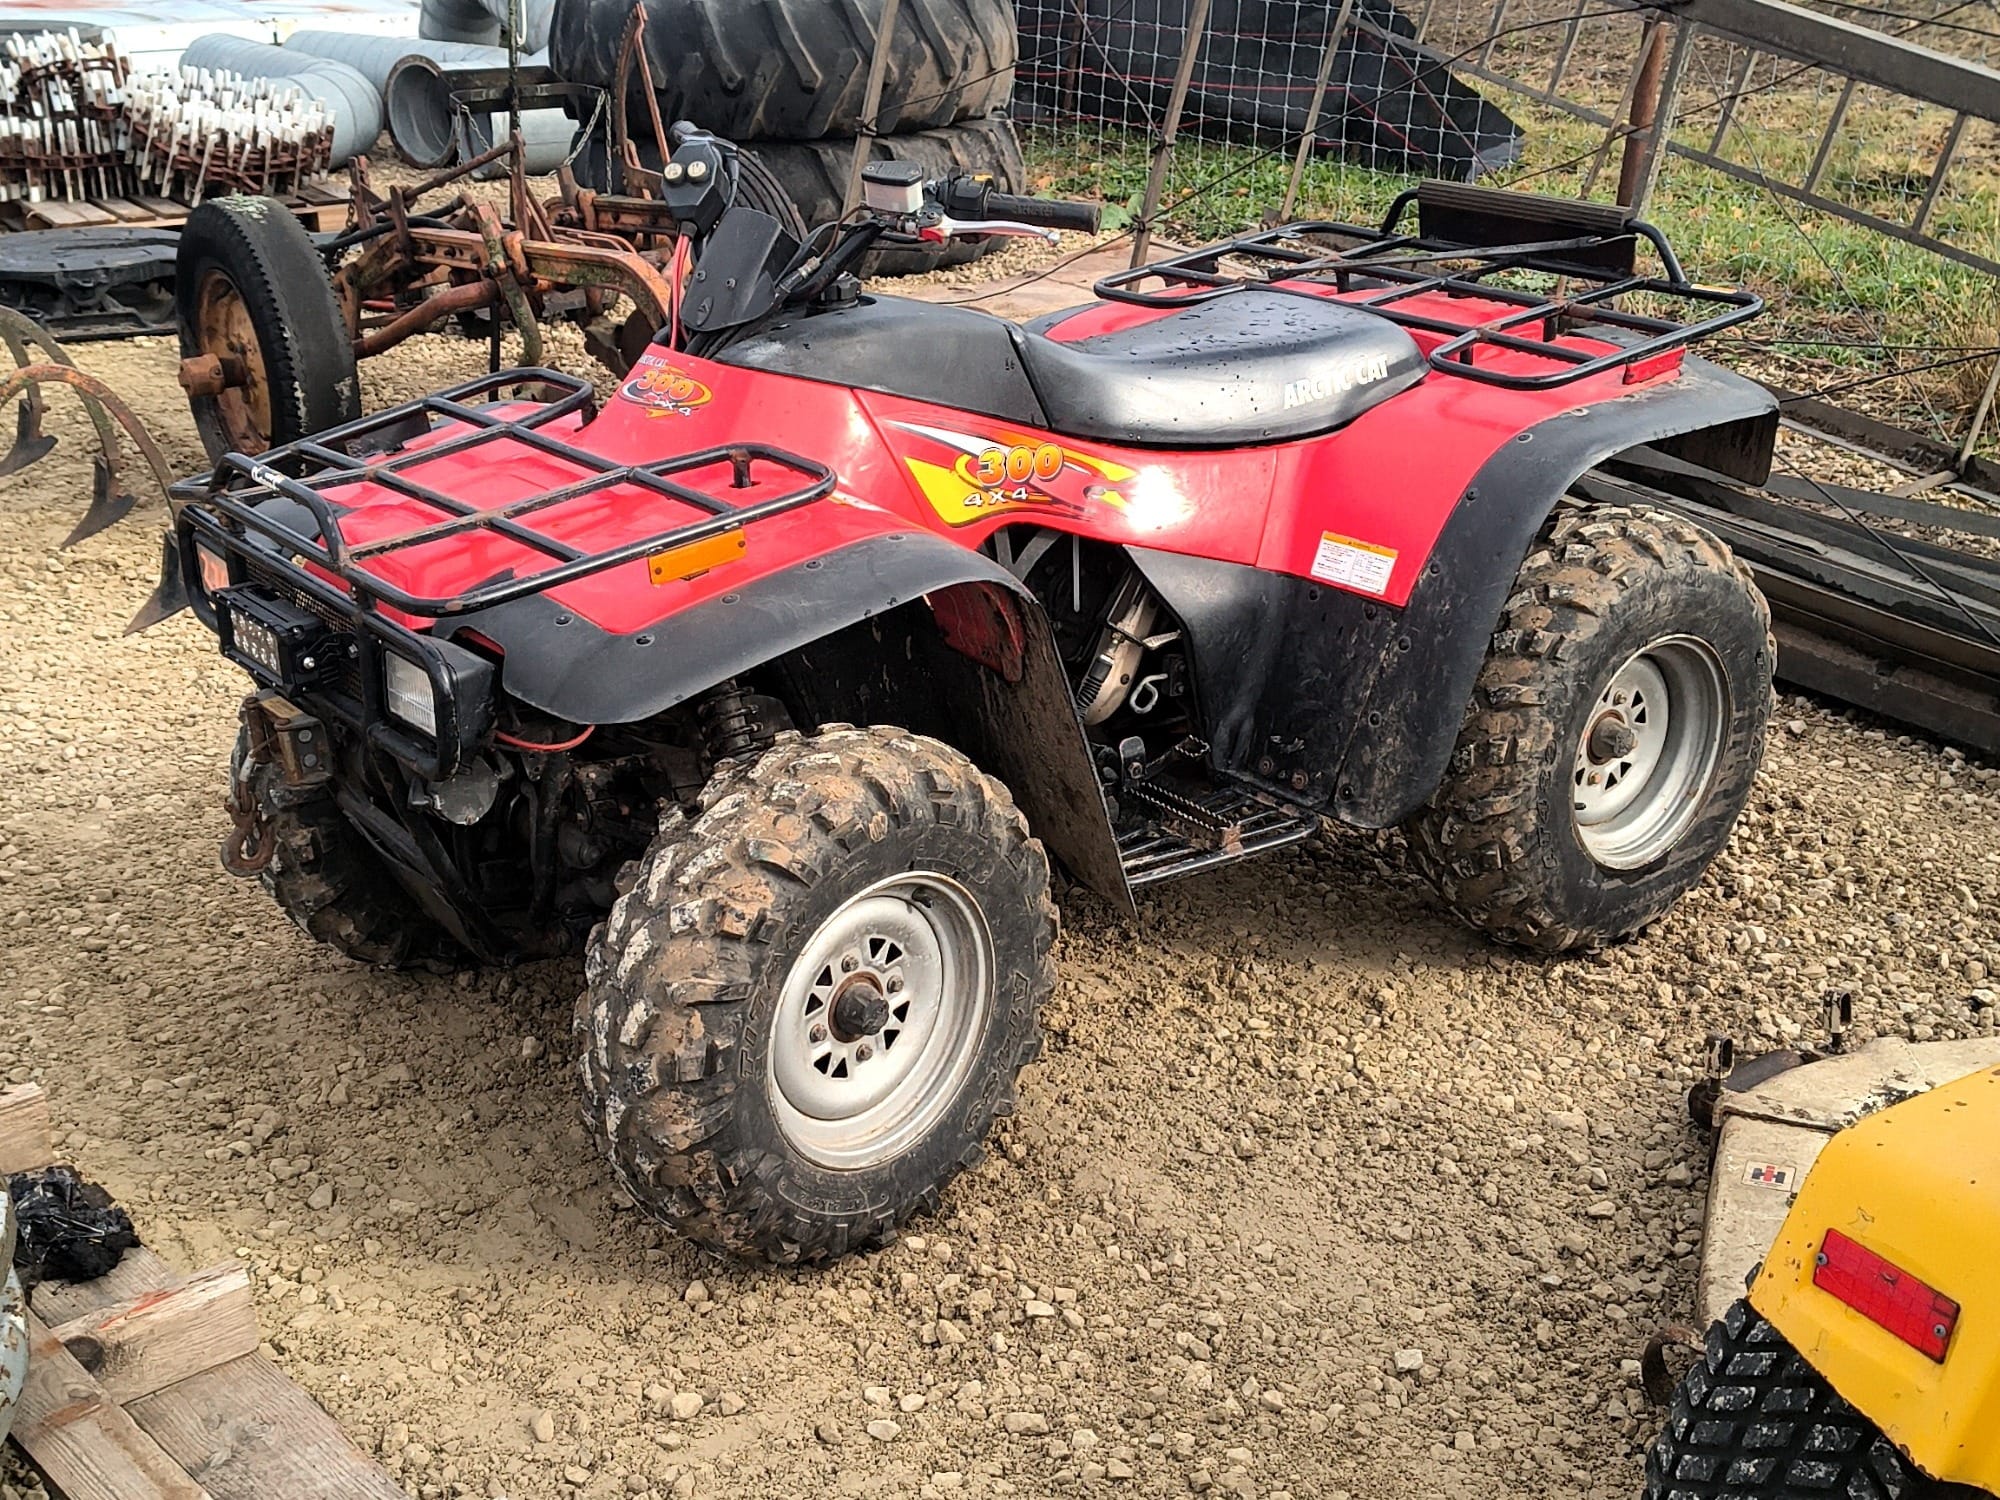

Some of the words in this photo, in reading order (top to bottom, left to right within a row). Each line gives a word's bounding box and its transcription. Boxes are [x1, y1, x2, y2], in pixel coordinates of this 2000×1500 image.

[636, 368, 695, 400] 300
[1283, 364, 1353, 410] ARCTIC
[1355, 351, 1388, 385] CAT
[976, 442, 1063, 487] 300
